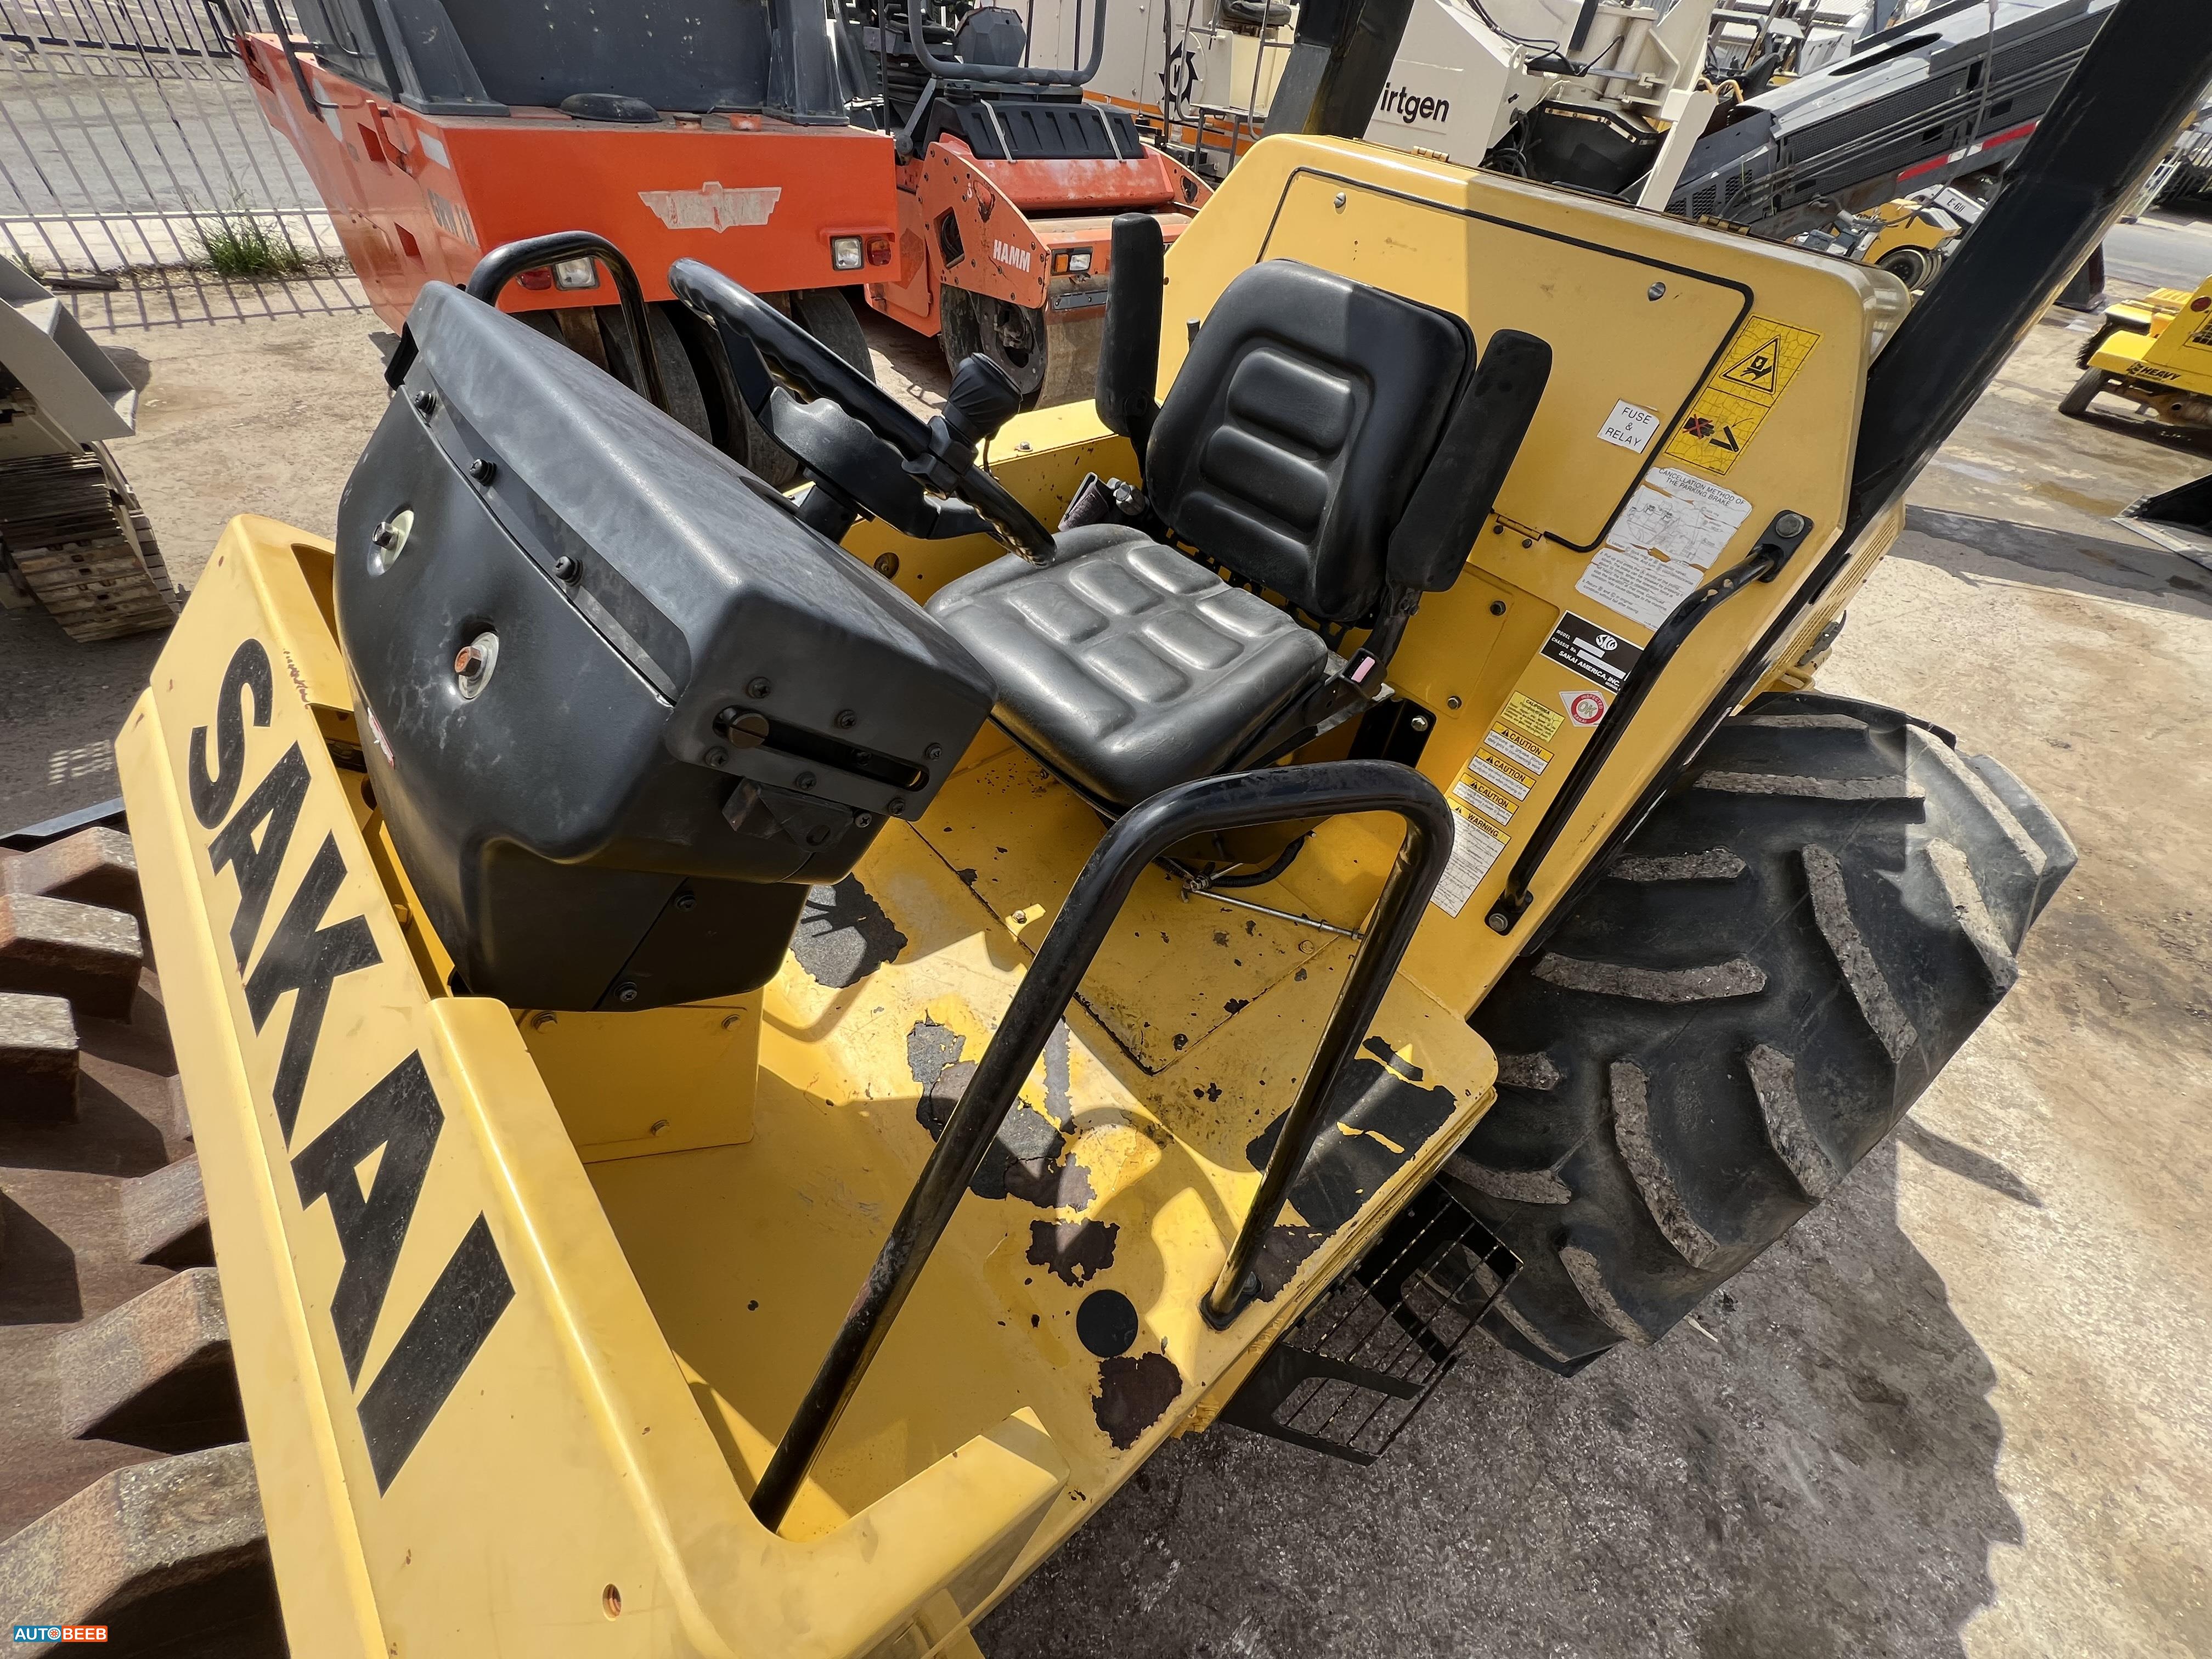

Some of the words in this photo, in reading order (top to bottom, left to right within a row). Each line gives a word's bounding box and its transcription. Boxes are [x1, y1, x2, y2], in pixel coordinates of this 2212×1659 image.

[1380, 82, 1449, 123] irtgen
[993, 239, 1030, 273] HAMM
[2140, 366, 2181, 380] HEAVY
[1622, 407, 1652, 425] FUSE
[1625, 422, 1633, 431] &
[1605, 427, 1641, 447] RELAY
[1659, 468, 1706, 490] CANCELLATION
[1707, 487, 1734, 502] METHOD
[1666, 477, 1678, 486] THE
[1679, 482, 1707, 497] PARKING
[1707, 494, 1731, 506] BRAKE
[1551, 637, 1570, 649] CHASSIS
[1559, 651, 1578, 664] SAKAI
[1577, 661, 1607, 681] AMERICA,
[1607, 676, 1620, 687] INC.
[1577, 701, 1597, 717] OK
[1581, 695, 1603, 709] INSPECTED
[1574, 714, 1587, 723] SAKAI
[1509, 733, 1542, 755] CAUTION
[1494, 760, 1526, 782] CAUTION
[1478, 785, 1509, 808] CAUTION
[1468, 812, 1499, 838] WARNING
[188, 637, 515, 1499] SAKAI
